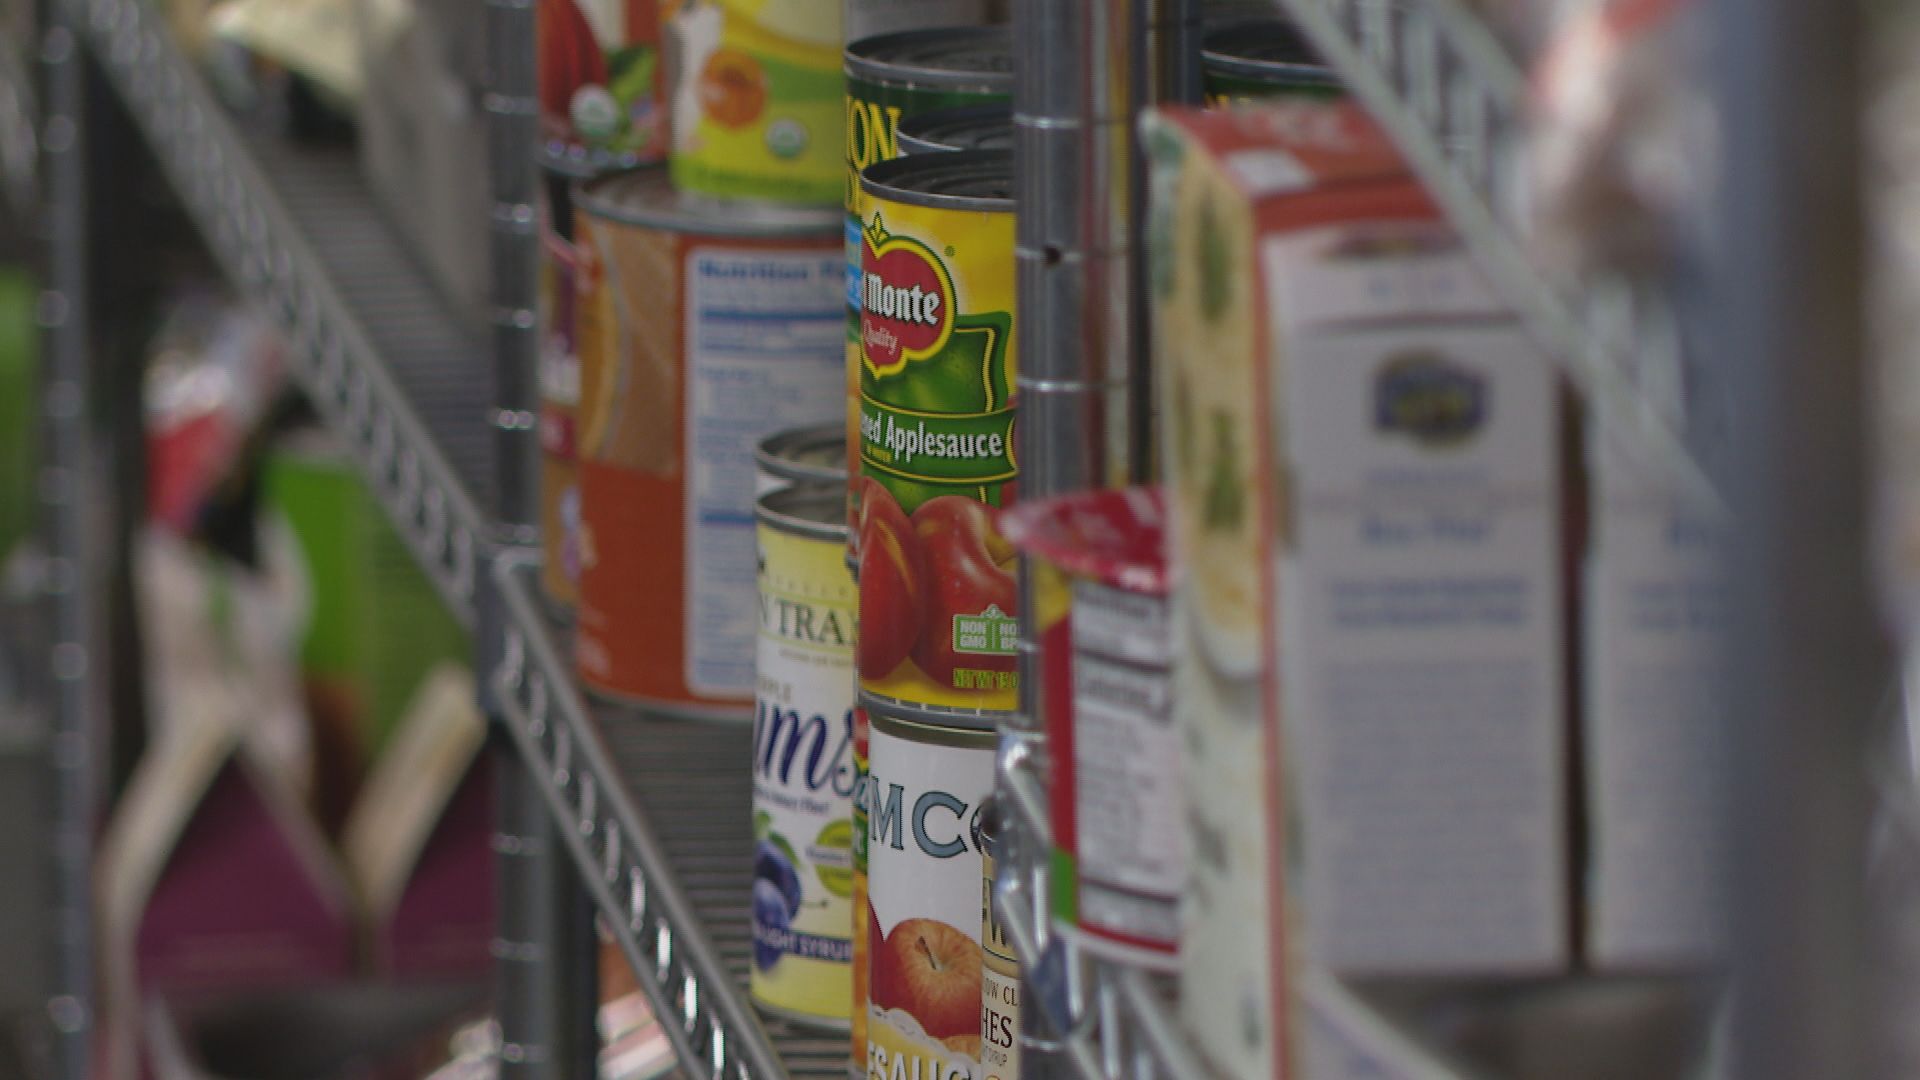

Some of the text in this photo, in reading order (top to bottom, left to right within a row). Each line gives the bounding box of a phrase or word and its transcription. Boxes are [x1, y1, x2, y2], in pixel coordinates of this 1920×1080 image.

[867, 272, 941, 325] Monte
[885, 415, 1003, 463] Applesauce
[960, 621, 986, 634] NON
[960, 635, 987, 649] GMO
